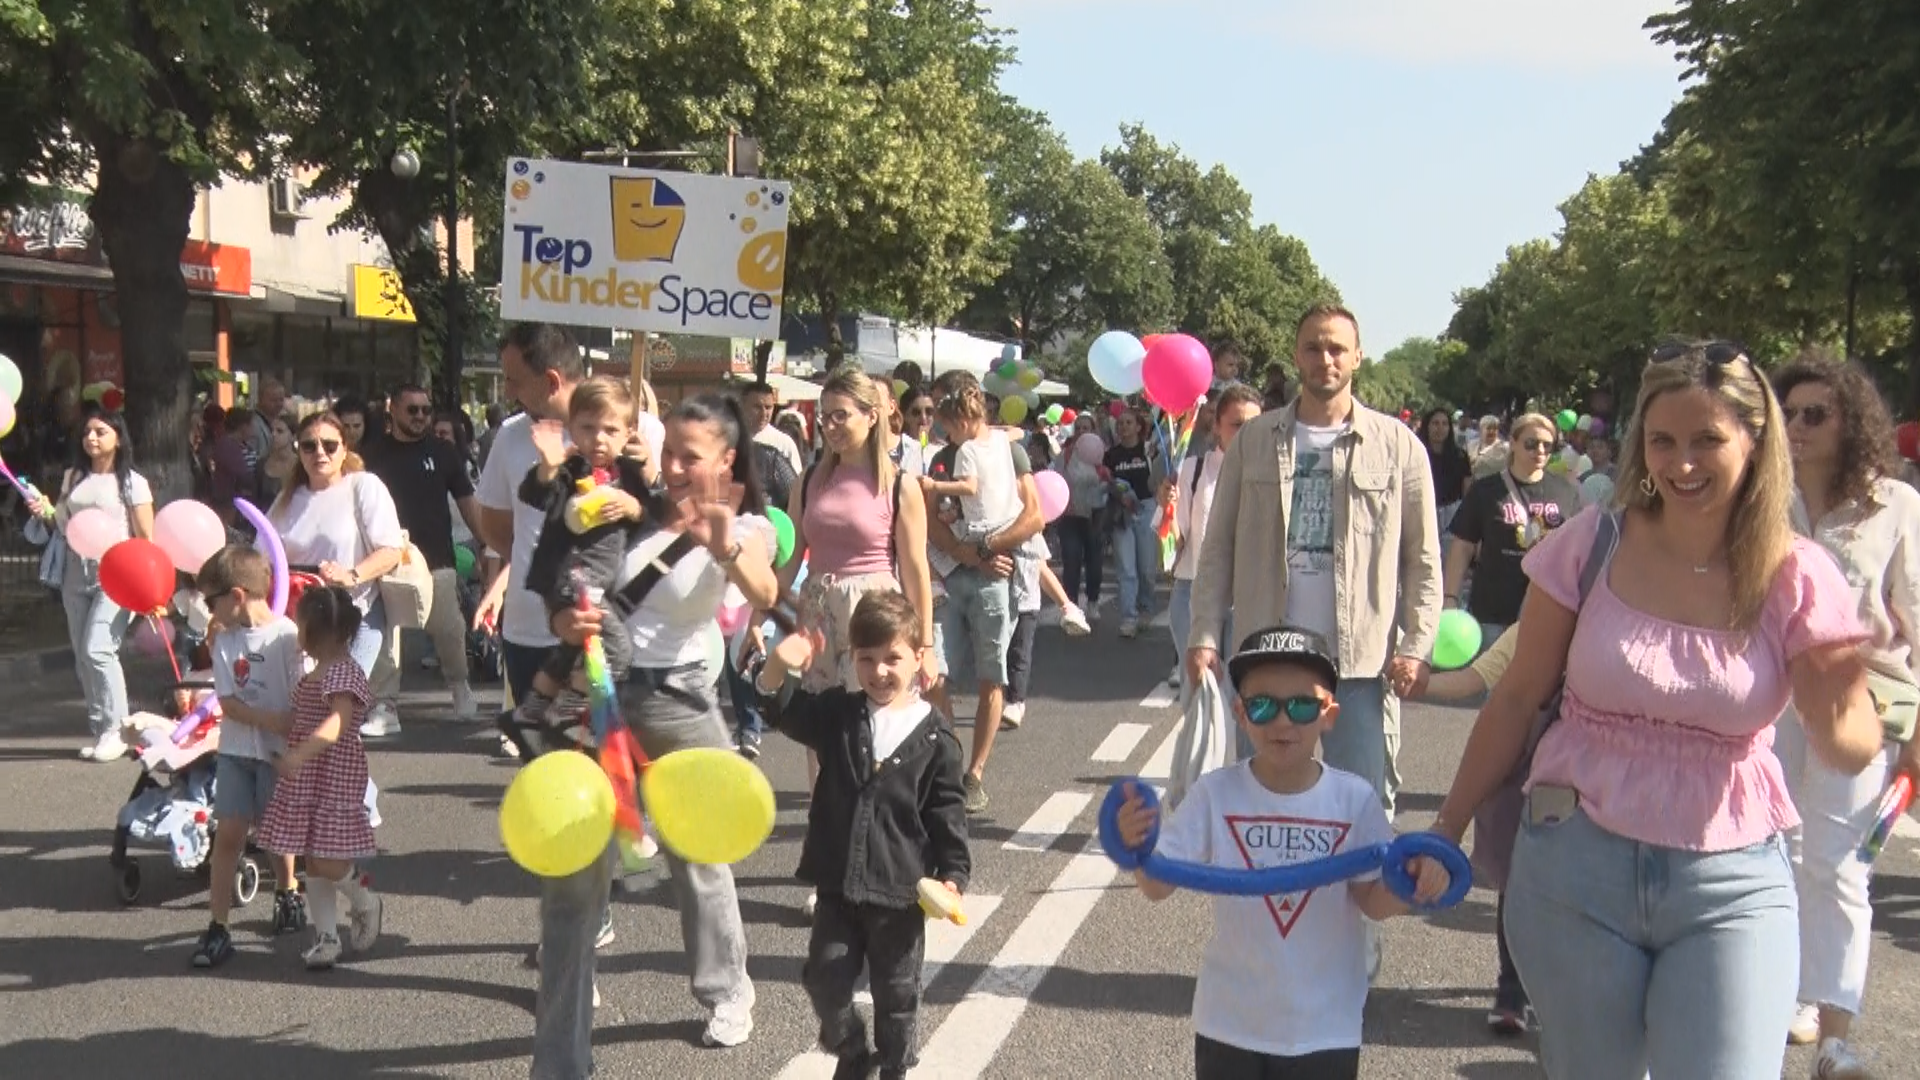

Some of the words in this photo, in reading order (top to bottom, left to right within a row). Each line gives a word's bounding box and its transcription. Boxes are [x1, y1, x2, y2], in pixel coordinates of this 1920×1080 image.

[513, 224, 592, 275] Top
[520, 262, 772, 326] KinderSpace
[1260, 631, 1305, 652] NYC
[1245, 824, 1330, 854] GUESS
